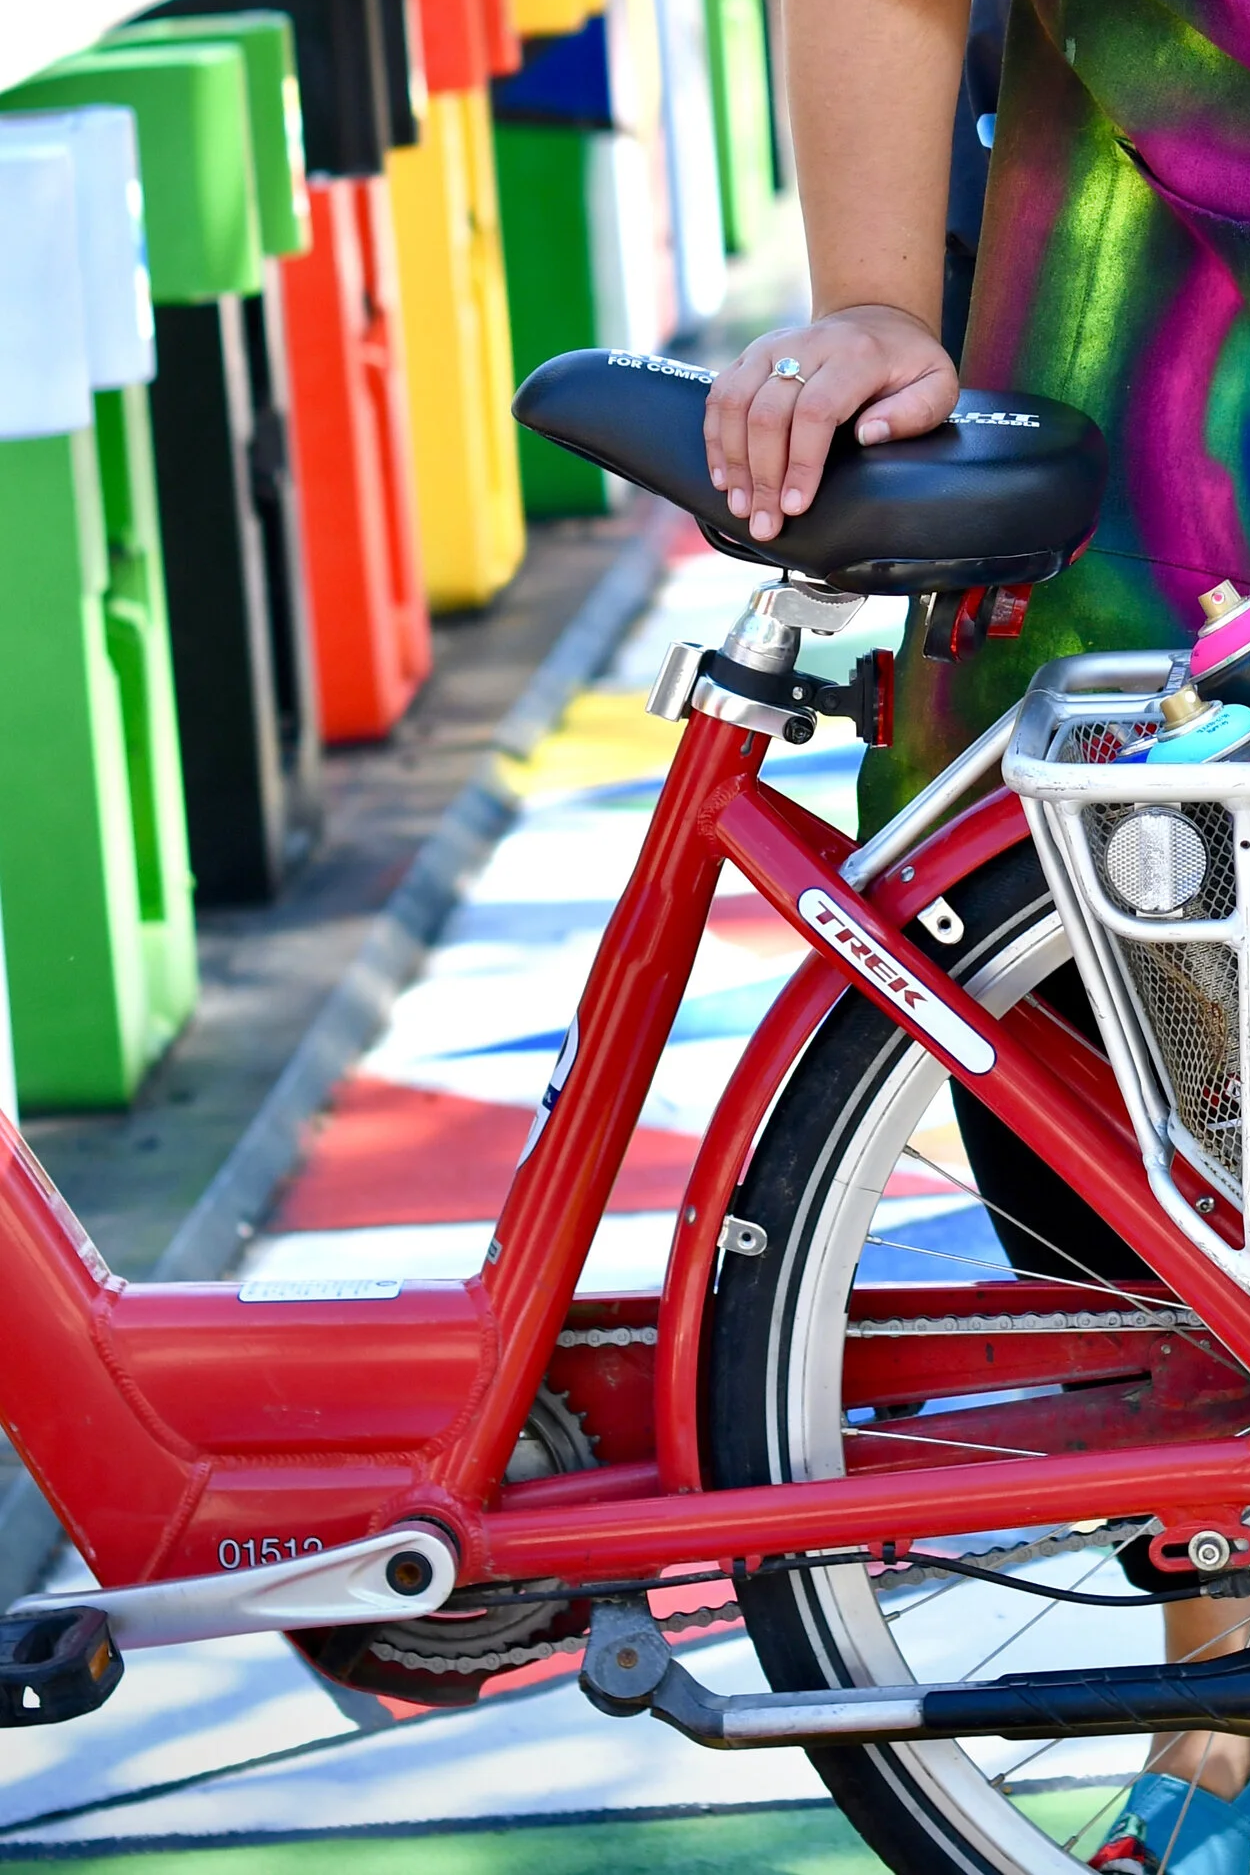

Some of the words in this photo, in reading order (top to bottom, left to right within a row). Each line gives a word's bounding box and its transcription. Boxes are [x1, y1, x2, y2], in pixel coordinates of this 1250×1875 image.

[608, 356, 643, 369] FOR
[646, 363, 713, 384] COMFO
[815, 900, 928, 1010] TREK
